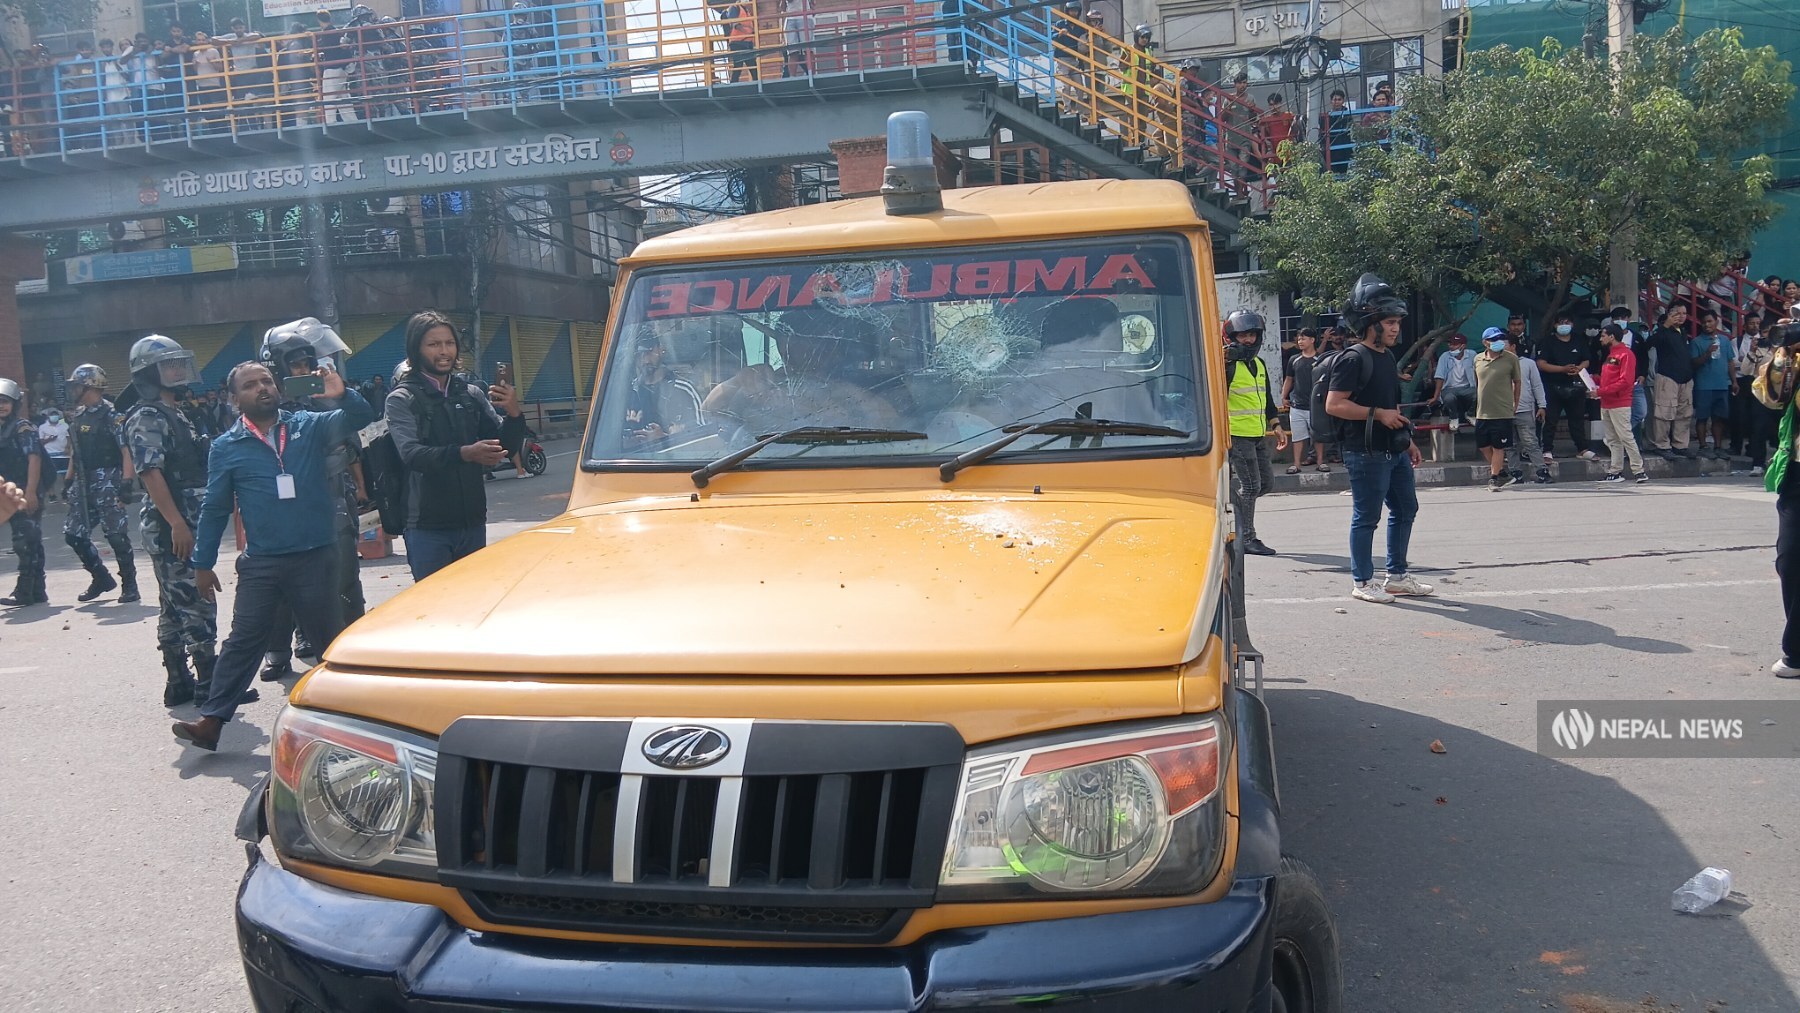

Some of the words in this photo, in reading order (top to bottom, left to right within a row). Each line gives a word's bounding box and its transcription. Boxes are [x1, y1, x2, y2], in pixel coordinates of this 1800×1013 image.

[204, 170, 249, 193] थापा
[252, 165, 309, 189] सडक,
[451, 146, 499, 174] द्वारा
[503, 133, 600, 166] संरक्षित
